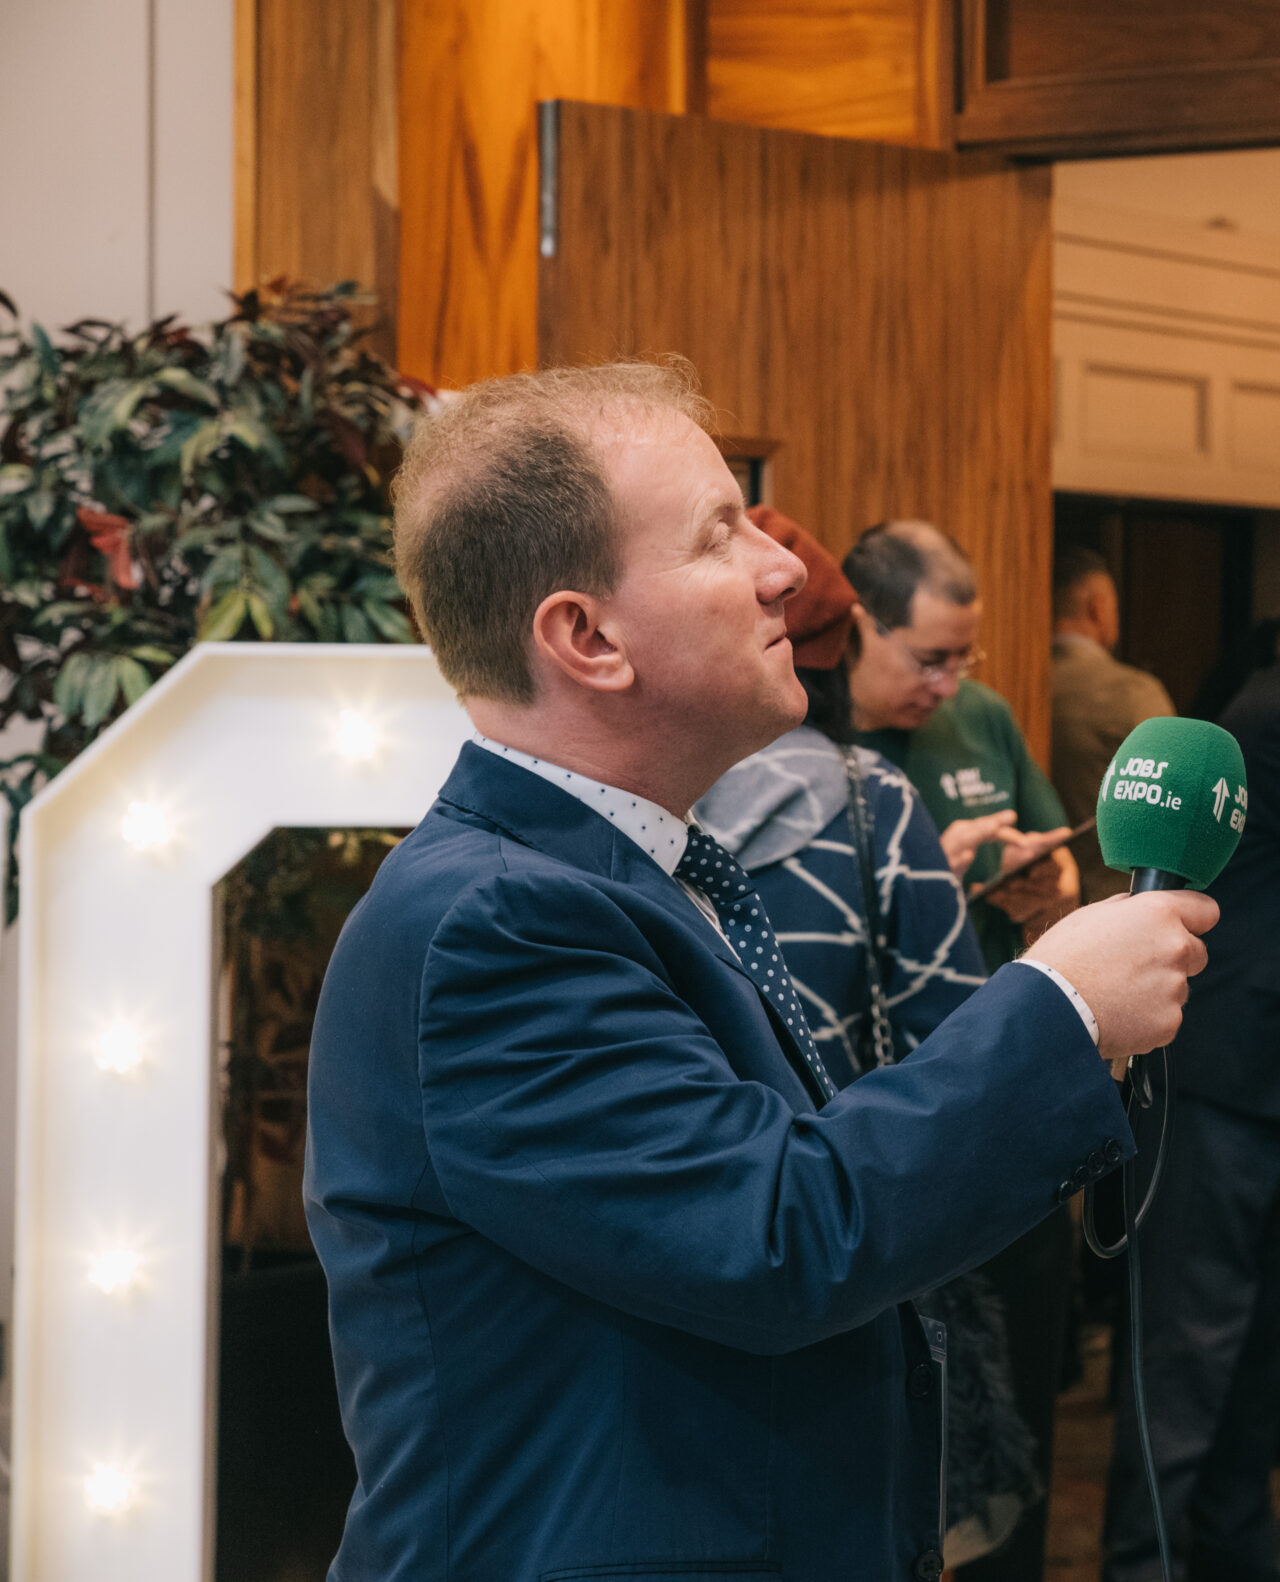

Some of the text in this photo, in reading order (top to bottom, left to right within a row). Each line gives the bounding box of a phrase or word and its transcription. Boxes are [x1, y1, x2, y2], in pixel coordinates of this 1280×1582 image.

[1120, 757, 1169, 779] JOBS
[1113, 780, 1182, 811] EXPO.ie
[1234, 784, 1248, 811] JO
